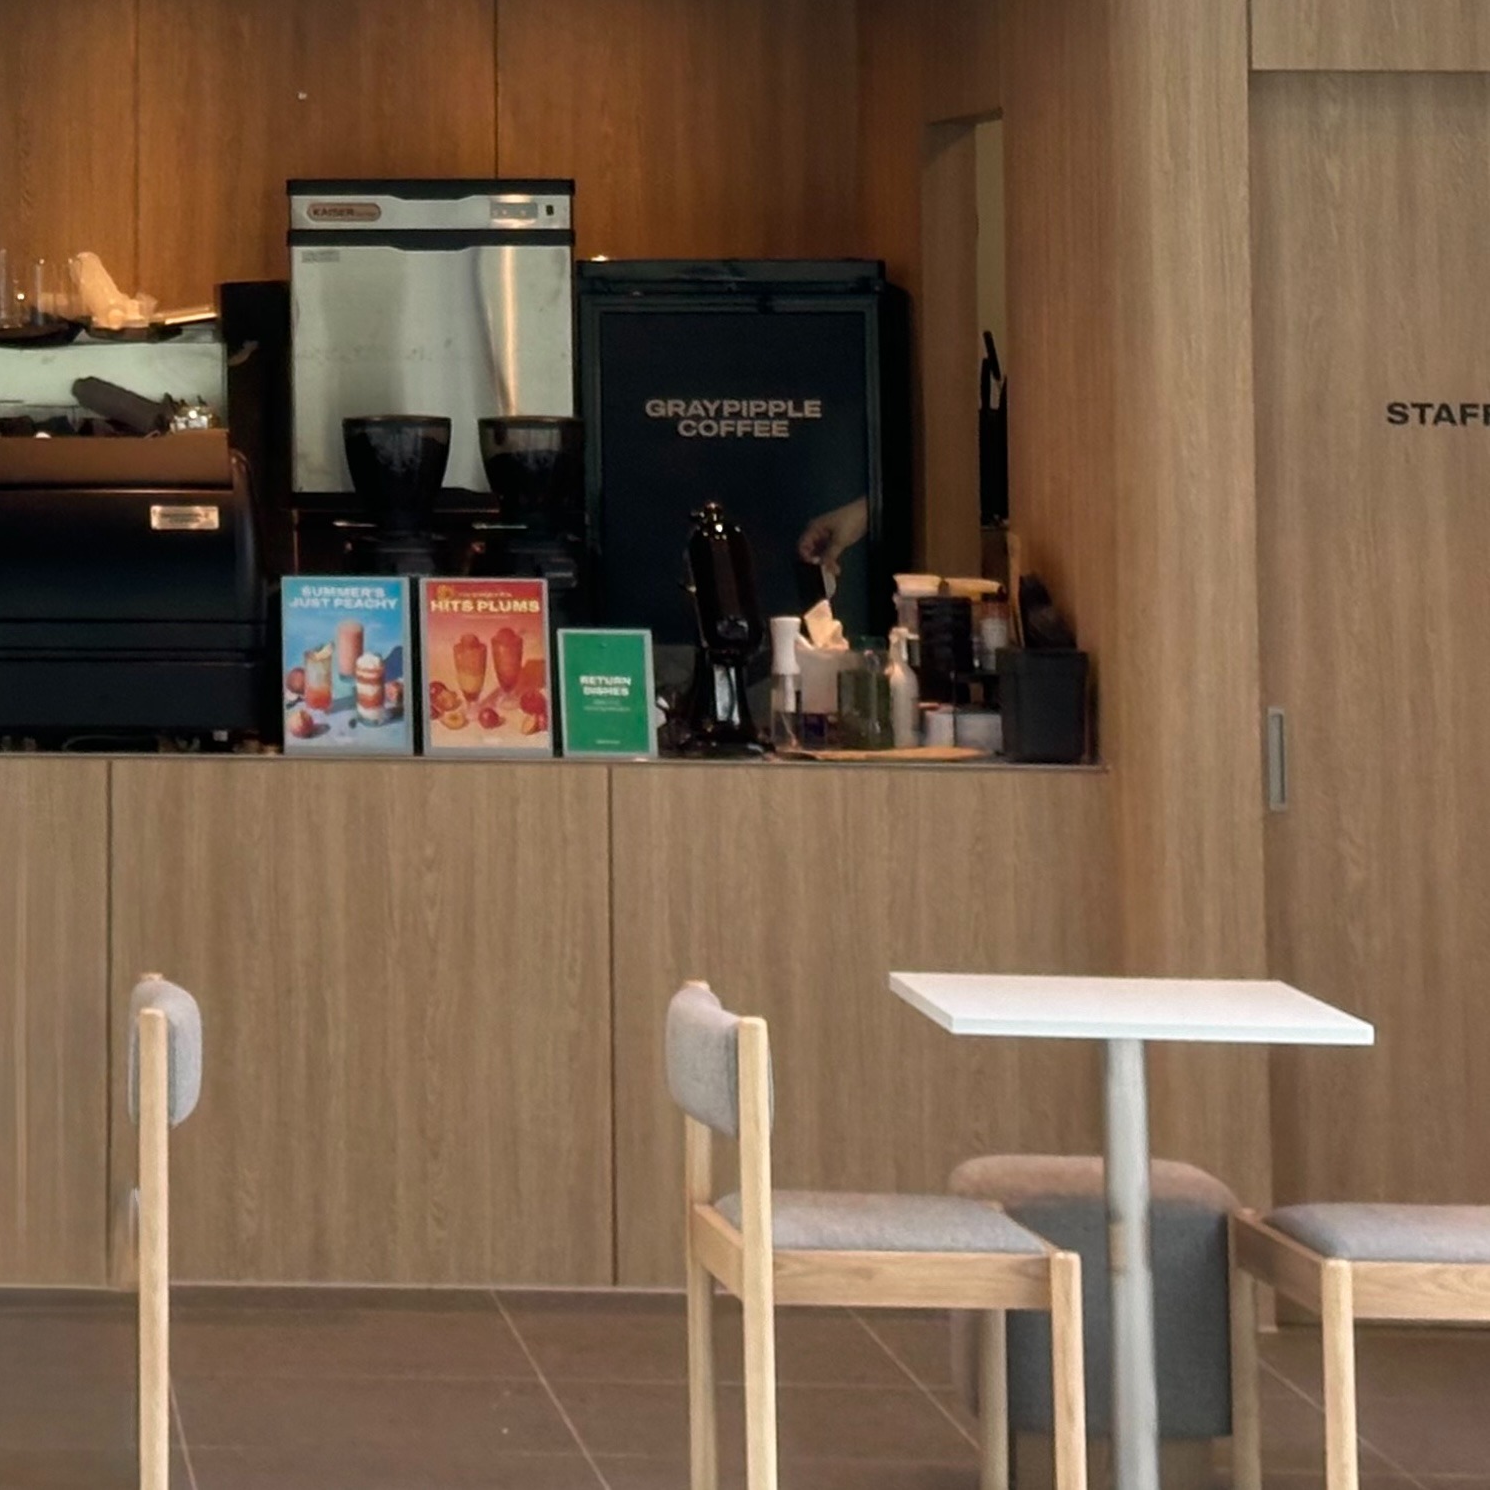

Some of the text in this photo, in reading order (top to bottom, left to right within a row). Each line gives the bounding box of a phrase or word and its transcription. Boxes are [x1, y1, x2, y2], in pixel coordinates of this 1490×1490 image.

[644, 398, 823, 419] GRAYPIPPLE
[676, 419, 791, 438] COFFEE
[289, 596, 399, 611] JUST PEACHY
[429, 599, 541, 614] HITS PLUMS
[578, 675, 632, 687] RETURN
